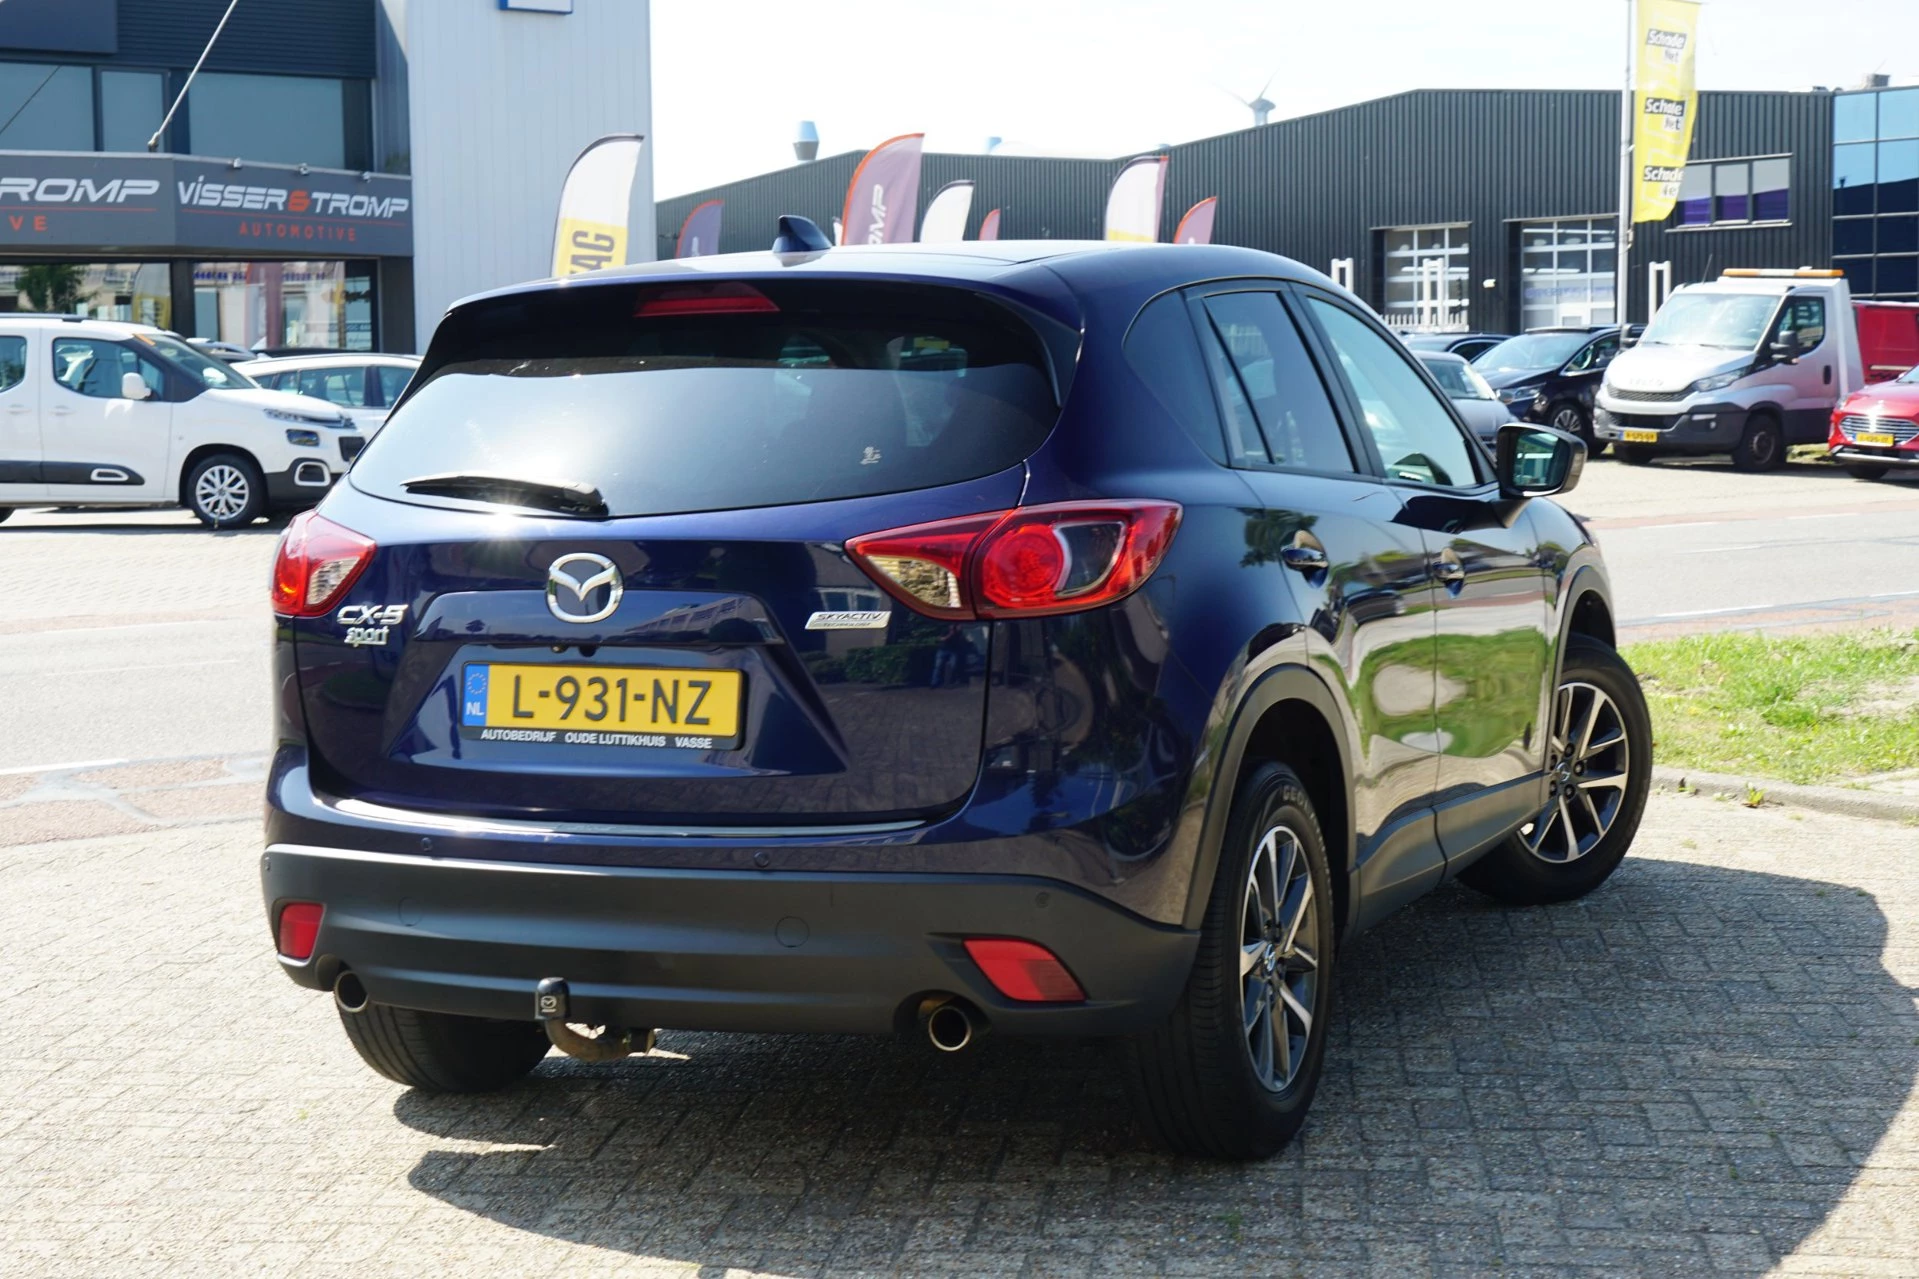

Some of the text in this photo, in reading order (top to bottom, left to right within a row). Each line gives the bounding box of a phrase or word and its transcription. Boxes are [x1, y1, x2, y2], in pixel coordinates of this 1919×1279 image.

[239, 221, 356, 241] AUTOMOTIVE
[337, 604, 409, 625] CX-5
[816, 613, 882, 621] SKYACTIV
[466, 702, 485, 716] NL
[512, 674, 712, 726] L-931-NZ
[481, 728, 712, 749] AUTOBEDRIJF OUDE LUTTIKHUIS VASSE
